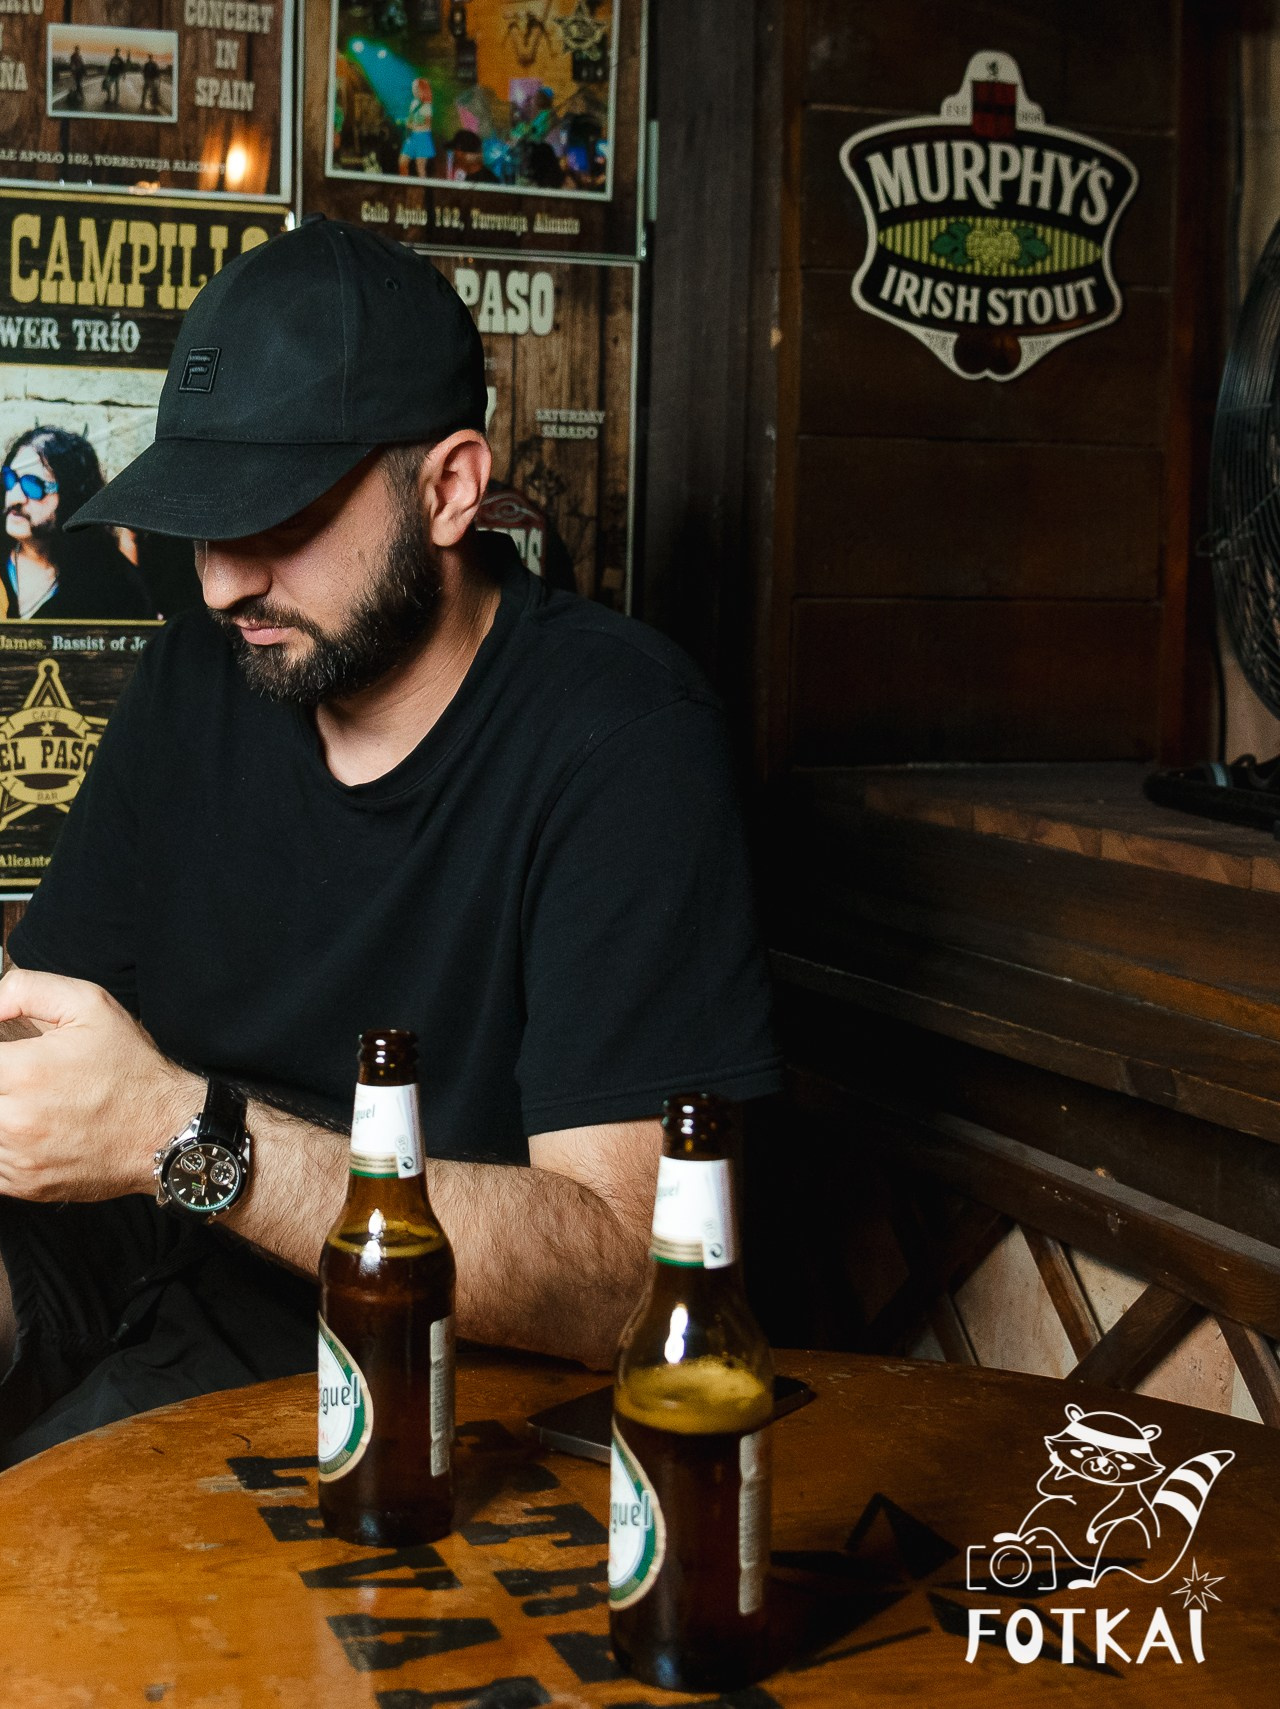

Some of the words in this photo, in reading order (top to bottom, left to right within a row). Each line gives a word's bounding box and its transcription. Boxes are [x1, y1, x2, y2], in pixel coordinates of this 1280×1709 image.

[184, 0, 275, 34] CONCERT
[215, 39, 240, 71] IN
[195, 76, 256, 112] SPAIN
[20, 149, 65, 164] APOLO
[94, 153, 171, 173] TORREVIEJA
[865, 140, 1115, 226] MURPHY'S
[453, 267, 556, 336] PASO
[878, 264, 982, 325] IRISH
[986, 276, 1098, 327] STOUT
[72, 312, 142, 353] TRÍO
[50, 634, 106, 651] Bassist
[110, 635, 126, 651] of
[40, 739, 98, 772] PASO
